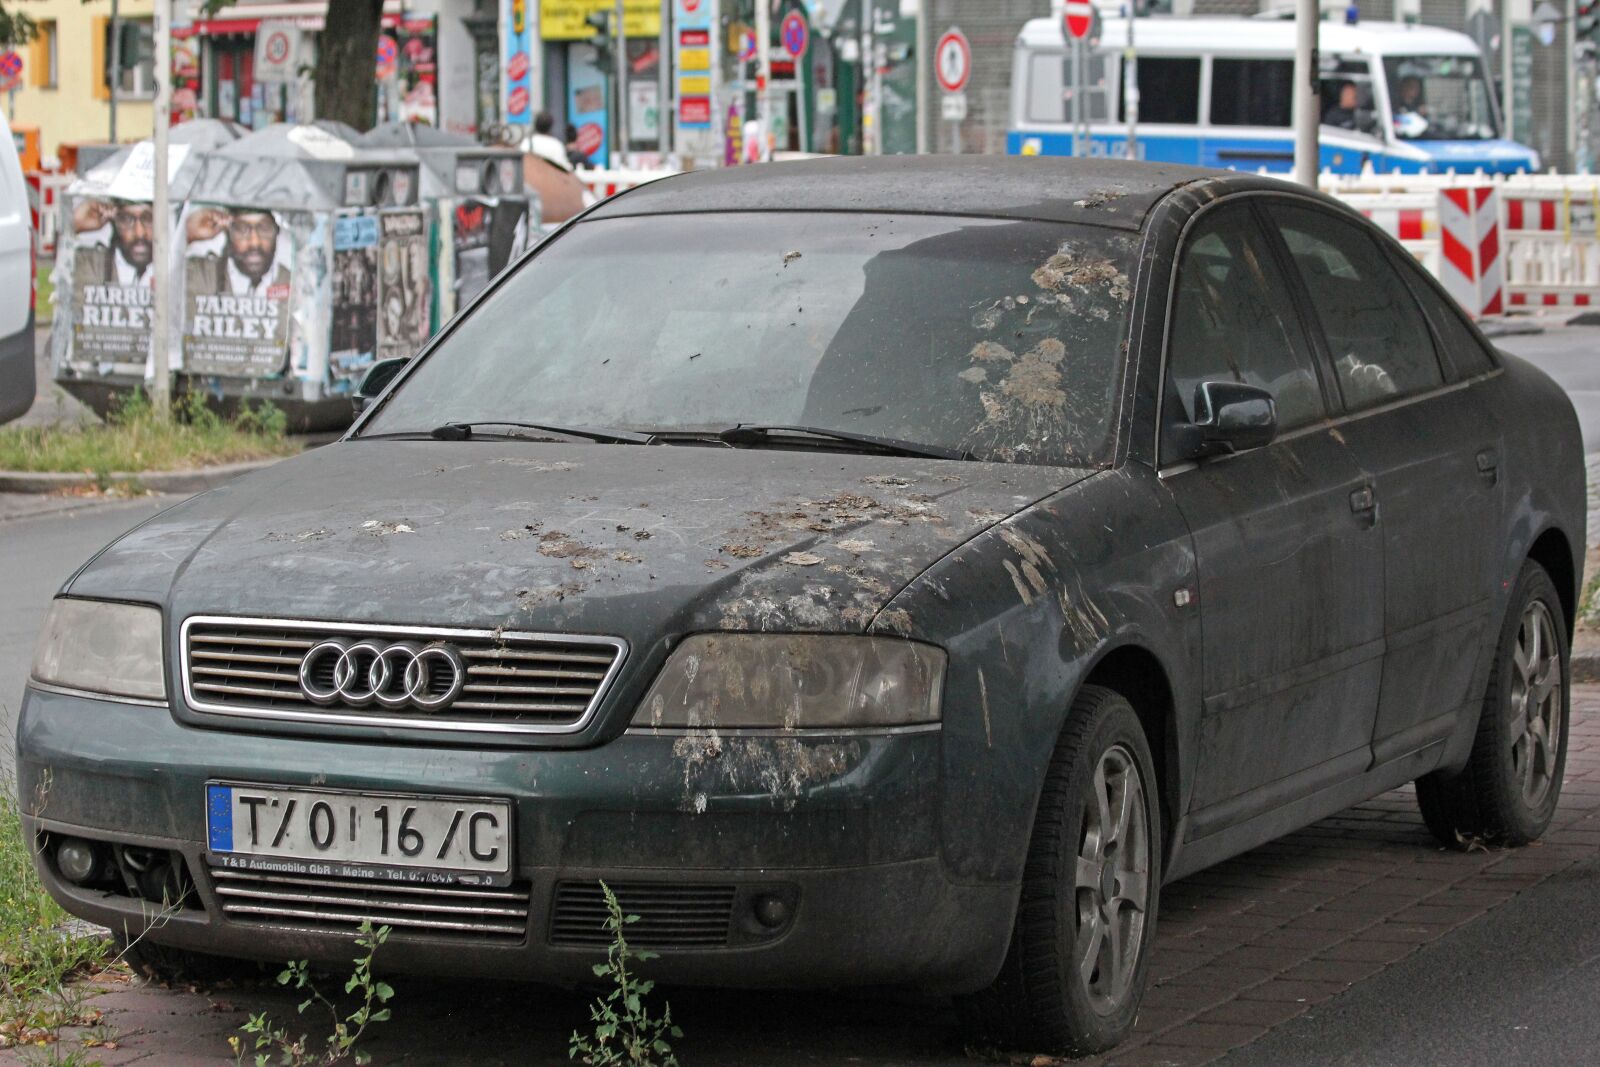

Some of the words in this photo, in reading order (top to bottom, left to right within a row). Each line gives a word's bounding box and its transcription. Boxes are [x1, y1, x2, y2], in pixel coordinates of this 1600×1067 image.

[83, 285, 155, 307] TARRU
[195, 295, 278, 317] TARRUS
[192, 315, 277, 339] RILEY
[249, 859, 307, 873] Automobile
[309, 864, 331, 874] GbR
[387, 869, 406, 880] Tel.
